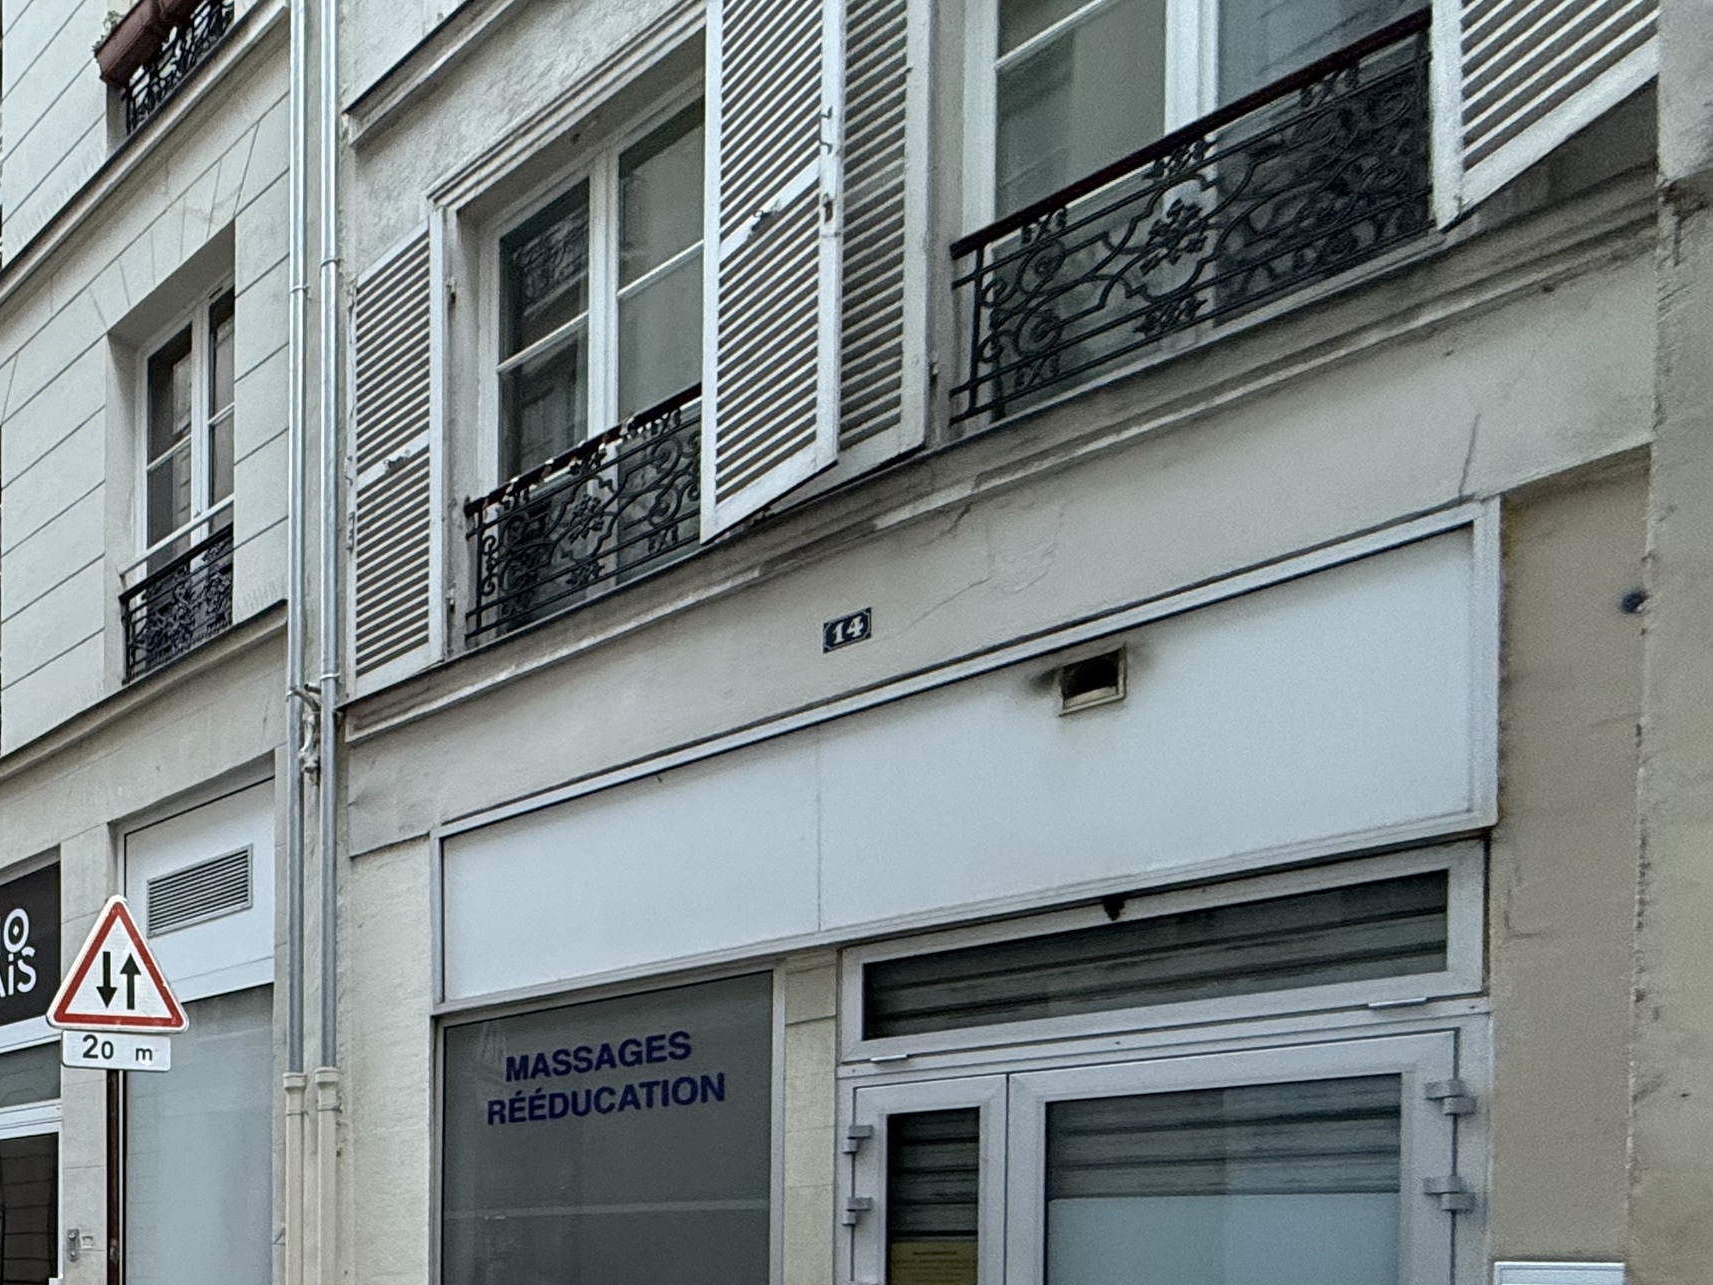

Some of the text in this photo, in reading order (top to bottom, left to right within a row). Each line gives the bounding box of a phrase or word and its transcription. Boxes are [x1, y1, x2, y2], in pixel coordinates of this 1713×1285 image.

[832, 615, 864, 645] 14
[82, 1034, 153, 1062] 20 m
[505, 1030, 692, 1083] MASSAGES
[486, 1072, 726, 1126] RÉÉDUCATION
